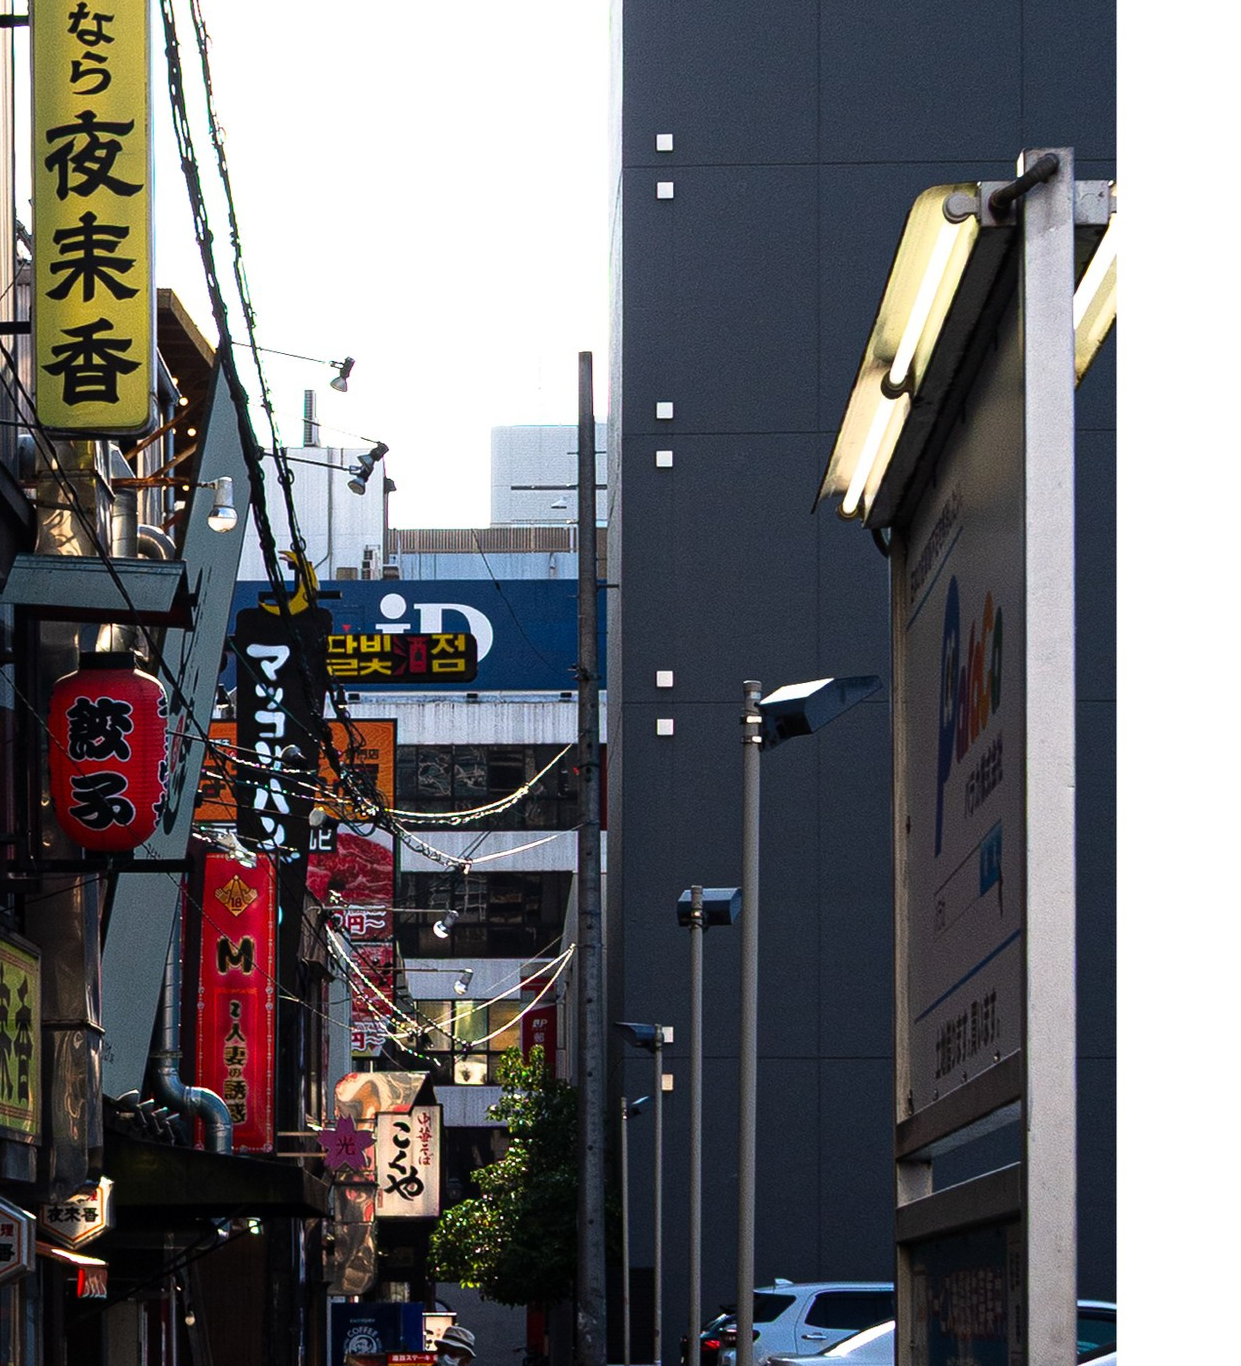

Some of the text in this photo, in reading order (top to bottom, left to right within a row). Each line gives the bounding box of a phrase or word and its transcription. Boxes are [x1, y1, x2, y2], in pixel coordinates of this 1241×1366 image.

[65, 696, 136, 831] 餃子
[230, 896, 243, 910] 18
[215, 935, 257, 976] M
[336, 1136, 356, 1157] 光
[416, 1112, 434, 1166] 中華そば
[383, 1121, 424, 1202] こくや
[346, 1325, 380, 1339] COFFEE
